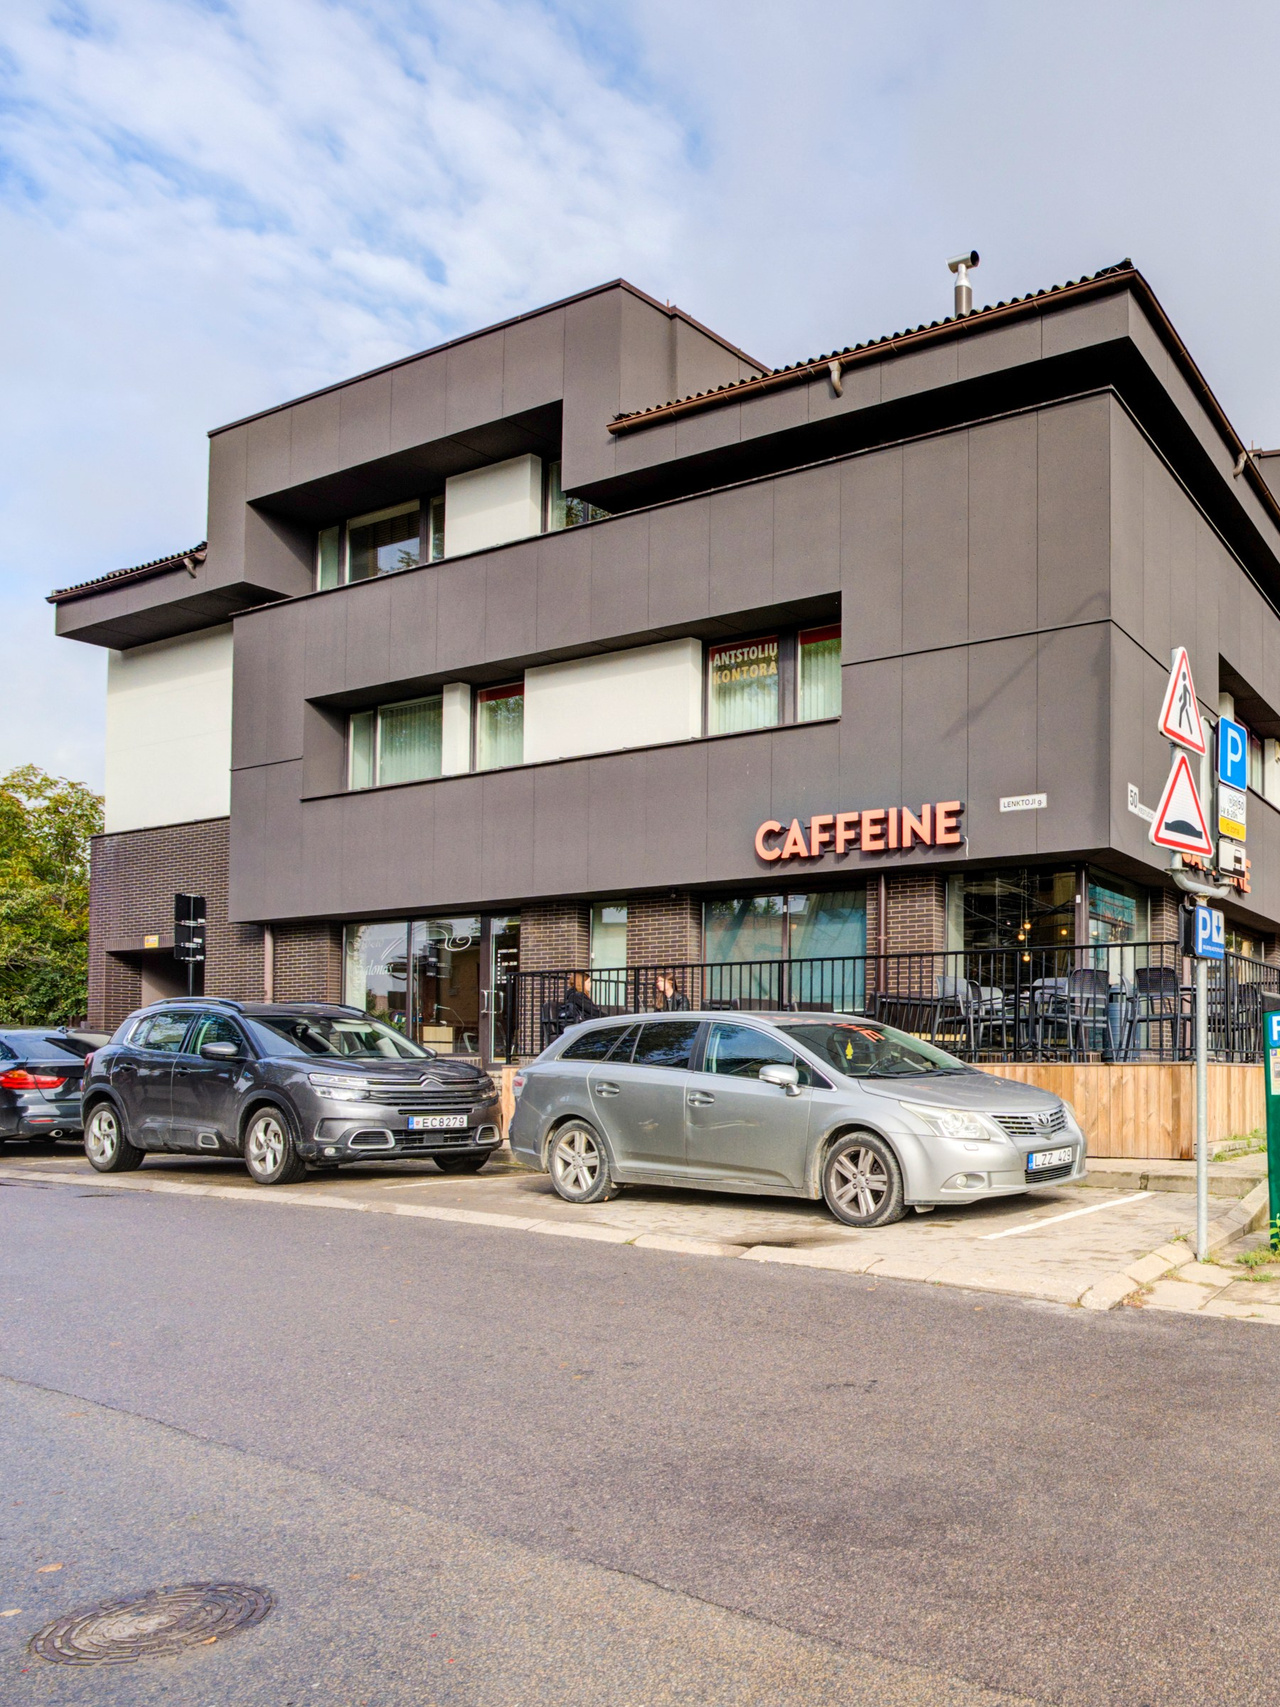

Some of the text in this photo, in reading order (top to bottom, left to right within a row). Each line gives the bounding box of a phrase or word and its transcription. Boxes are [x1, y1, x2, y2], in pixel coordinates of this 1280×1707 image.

[713, 642, 778, 667] ANTSTOLIŲ
[712, 661, 778, 685] KONTORA
[1227, 727, 1243, 777] P
[1003, 798, 1036, 809] LENKTOJI
[1129, 789, 1138, 809] 50
[754, 800, 962, 861] CAFFEINE
[1198, 908, 1210, 953] P
[422, 1116, 465, 1128] EC8279
[1034, 1149, 1071, 1167] LZZ 429
